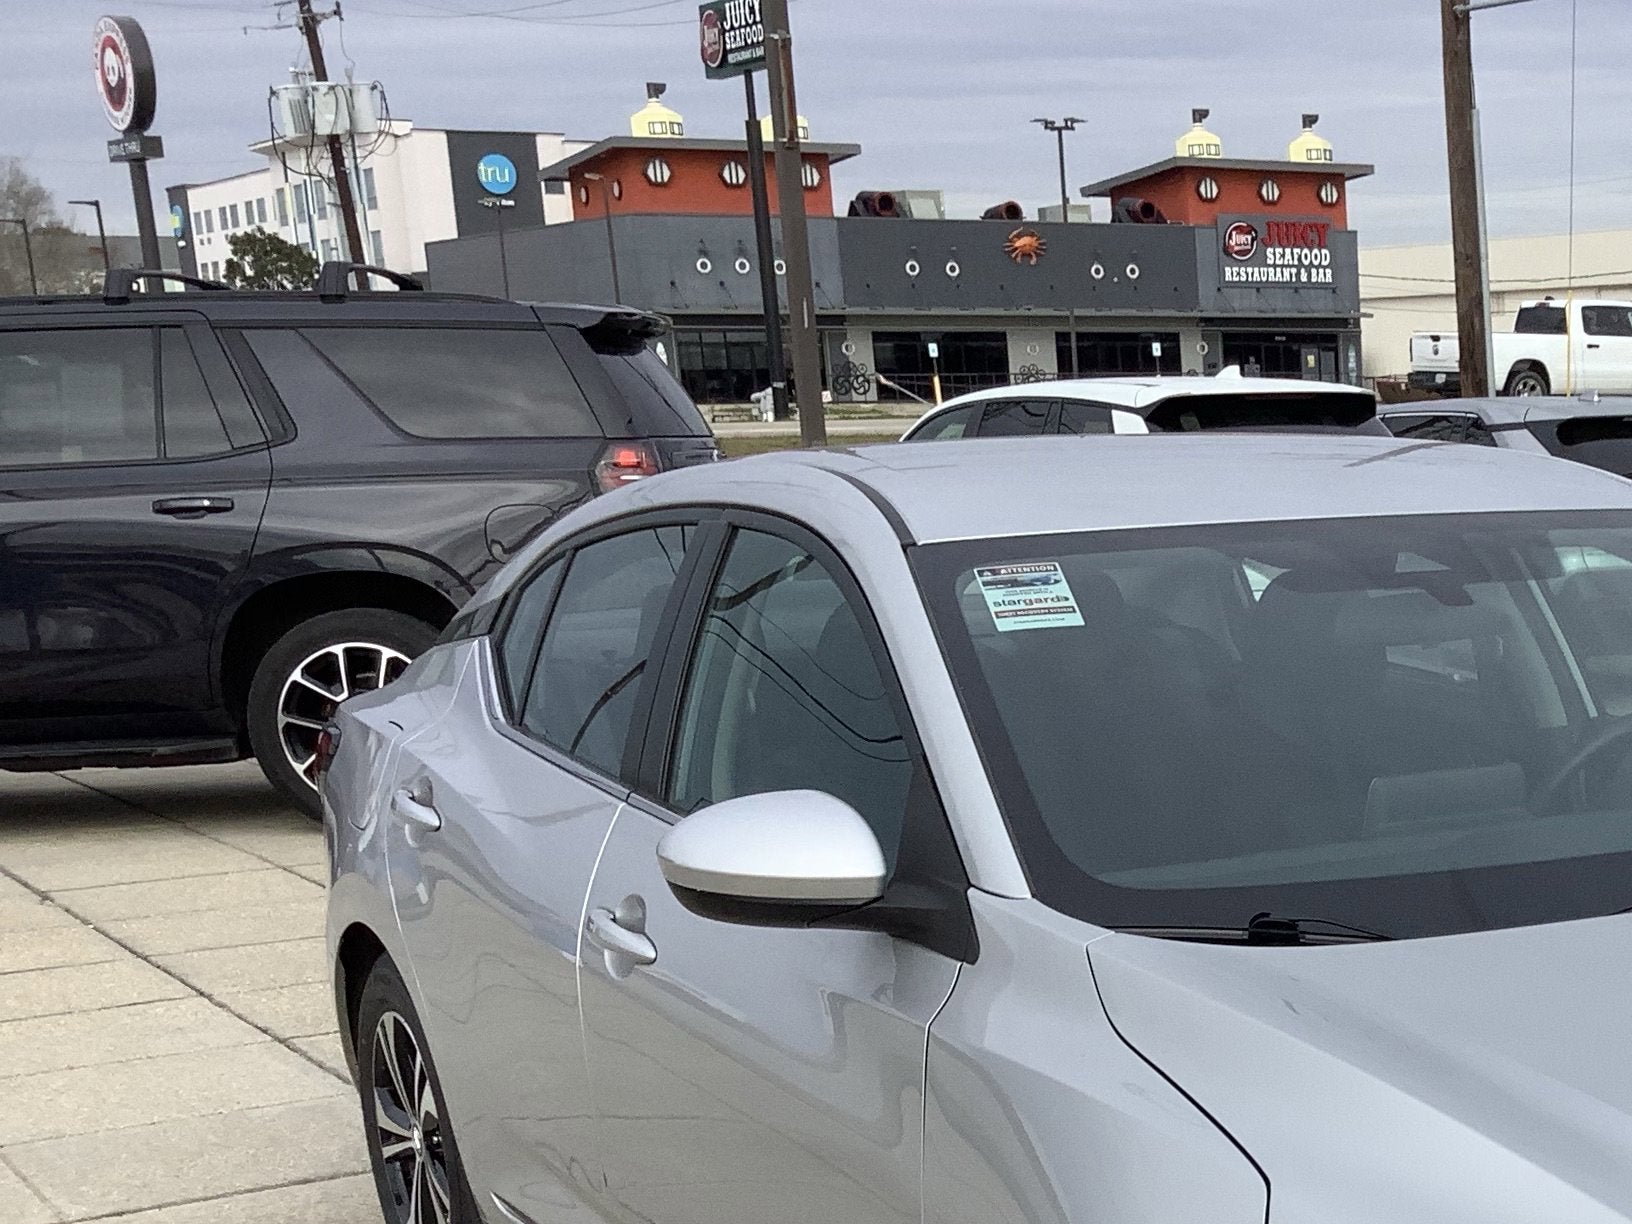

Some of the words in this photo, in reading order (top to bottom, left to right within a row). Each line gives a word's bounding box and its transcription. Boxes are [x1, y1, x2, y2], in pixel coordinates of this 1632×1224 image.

[723, 0, 761, 30] JUICY
[725, 23, 764, 50] SEAFOOD
[478, 161, 511, 183] tru
[1261, 221, 1330, 248] JUICY
[1266, 247, 1331, 266] SEAFOOD
[1224, 266, 1297, 282] RESTAURANT
[1300, 267, 1308, 282] &
[1311, 268, 1332, 283] BAR
[1000, 564, 1055, 575] ATTENTION
